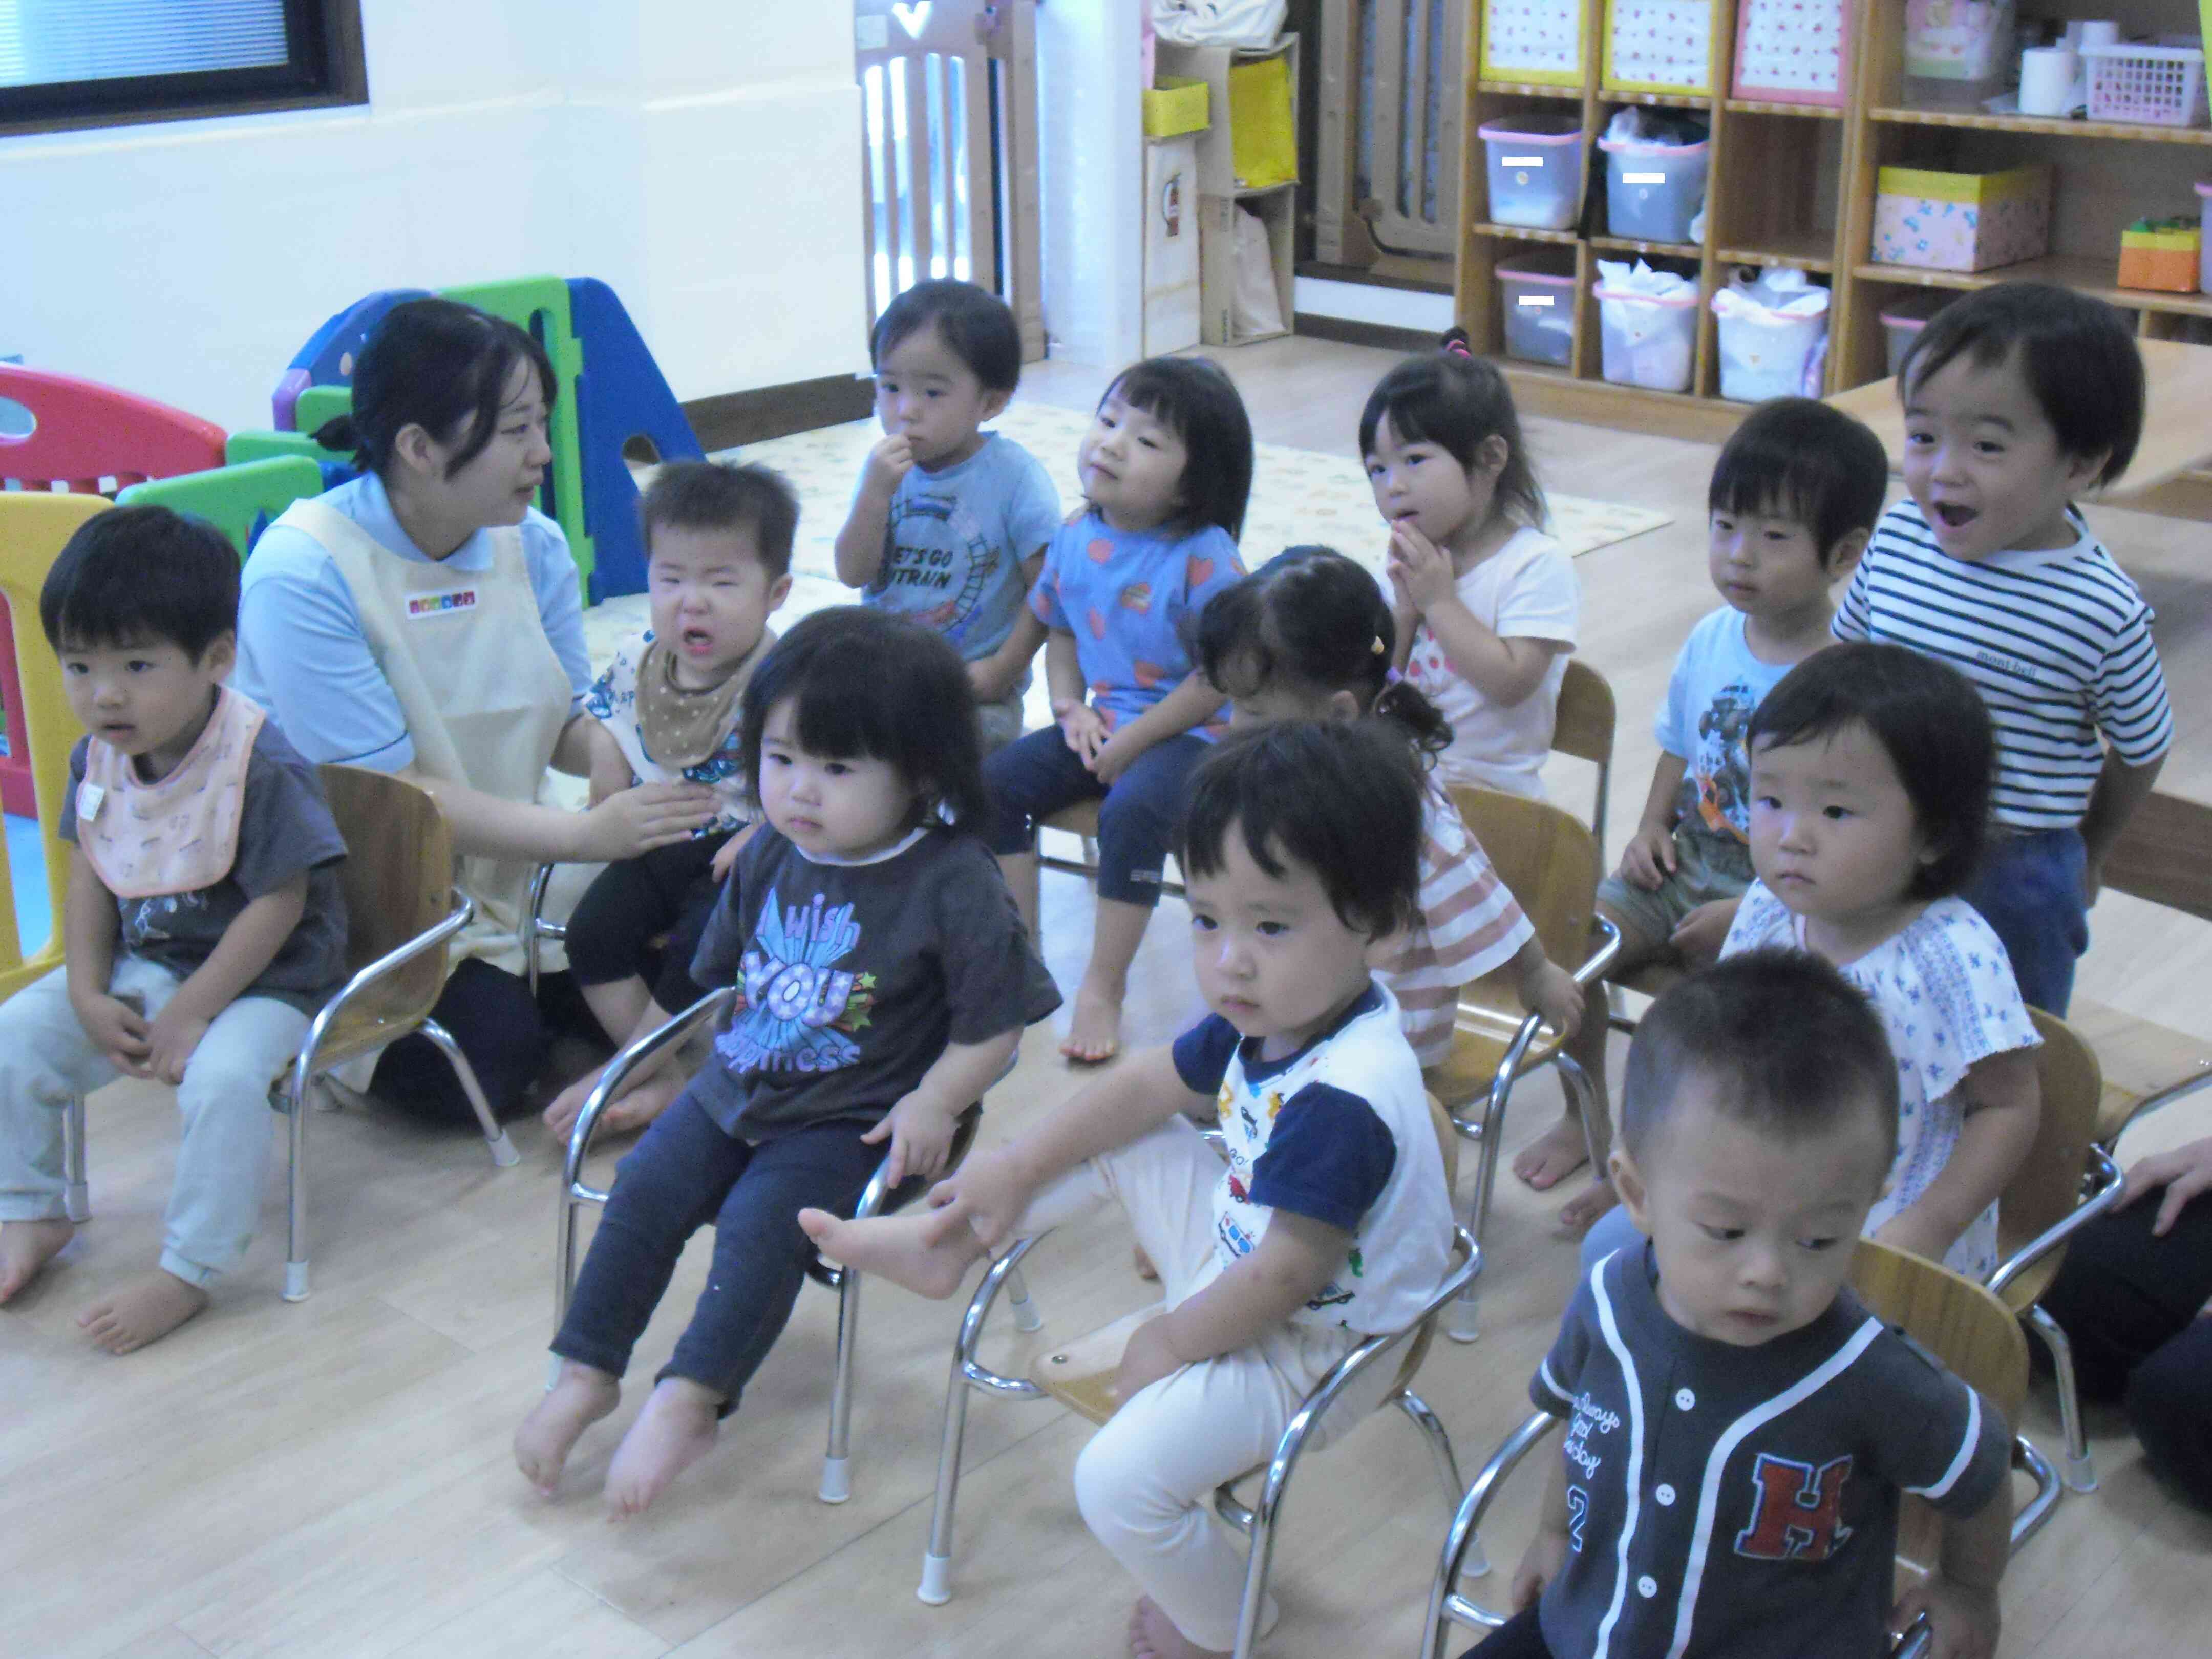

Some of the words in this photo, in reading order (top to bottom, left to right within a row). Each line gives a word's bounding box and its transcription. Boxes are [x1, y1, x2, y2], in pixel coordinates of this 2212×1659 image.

[889, 546, 928, 565] ET'S
[929, 548, 953, 568] GO
[892, 568, 951, 589] TRAIN
[1733, 1452, 1854, 1560] H
